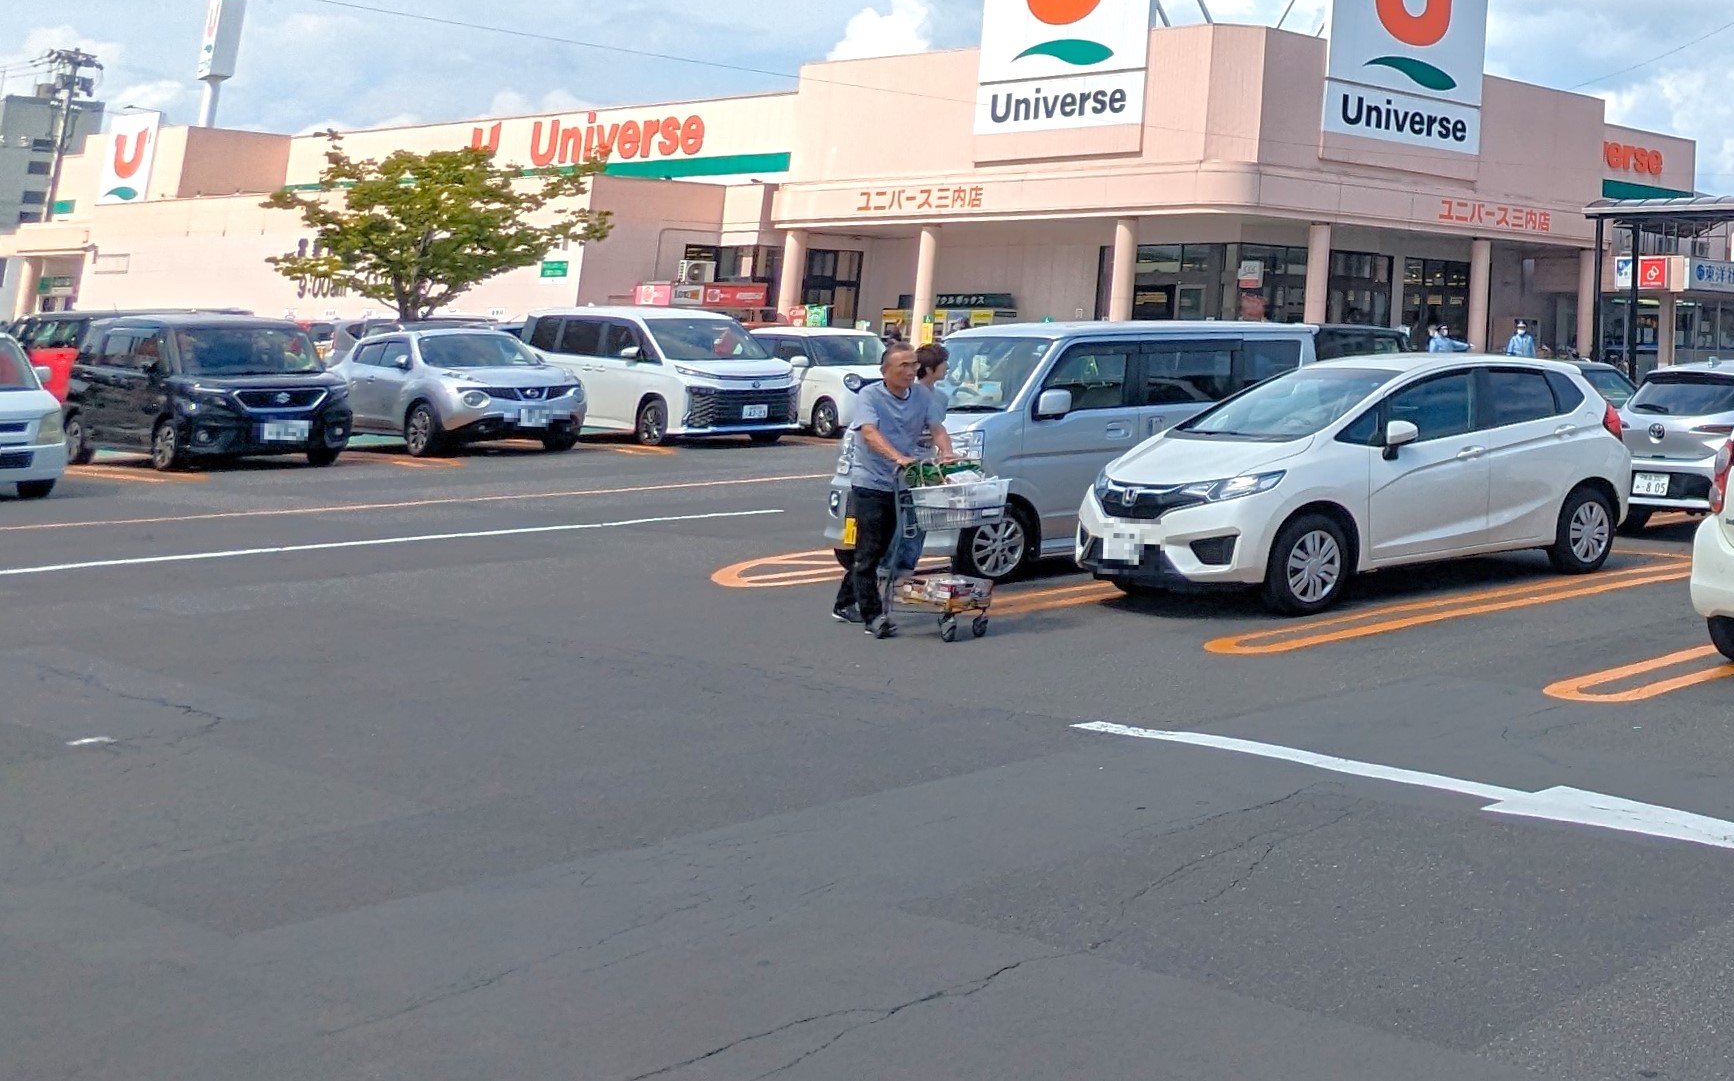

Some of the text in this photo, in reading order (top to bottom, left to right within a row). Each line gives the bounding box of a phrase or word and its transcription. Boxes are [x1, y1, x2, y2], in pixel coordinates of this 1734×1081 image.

[991, 87, 1126, 123] Universe
[1342, 93, 1467, 142] Universe
[531, 110, 705, 167] Universe
[857, 186, 983, 211] ユニバース三内店
[1438, 199, 1552, 232] ユニバース三内店
